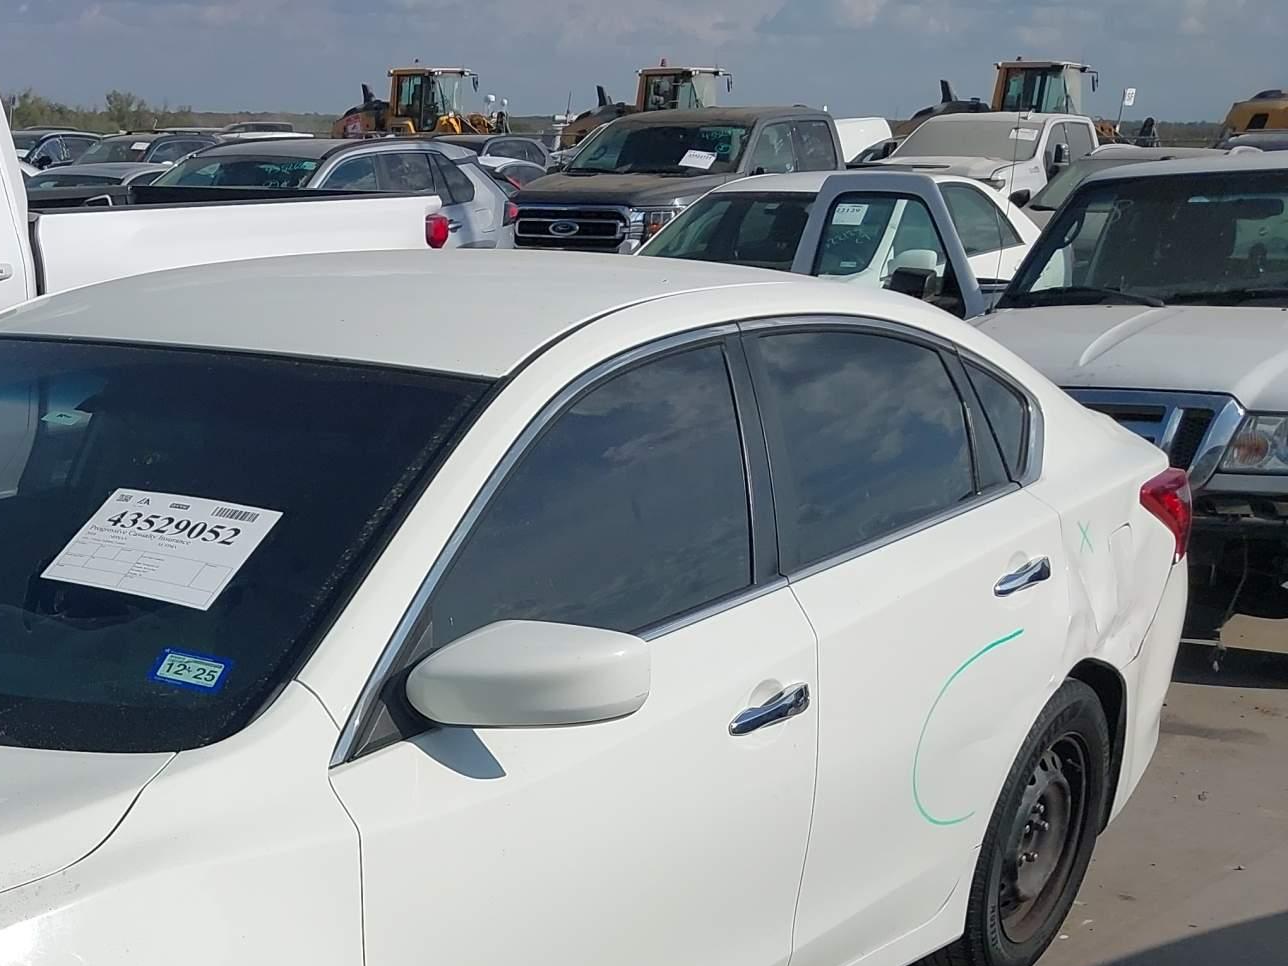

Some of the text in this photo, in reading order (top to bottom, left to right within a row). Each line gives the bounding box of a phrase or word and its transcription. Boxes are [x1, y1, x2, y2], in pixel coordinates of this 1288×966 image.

[89, 523, 127, 536] Progressive
[128, 529, 157, 541] Casualty
[157, 533, 192, 546] Insurance
[106, 509, 242, 546] 43529052
[166, 662, 187, 676] 12
[192, 667, 218, 682] 25
